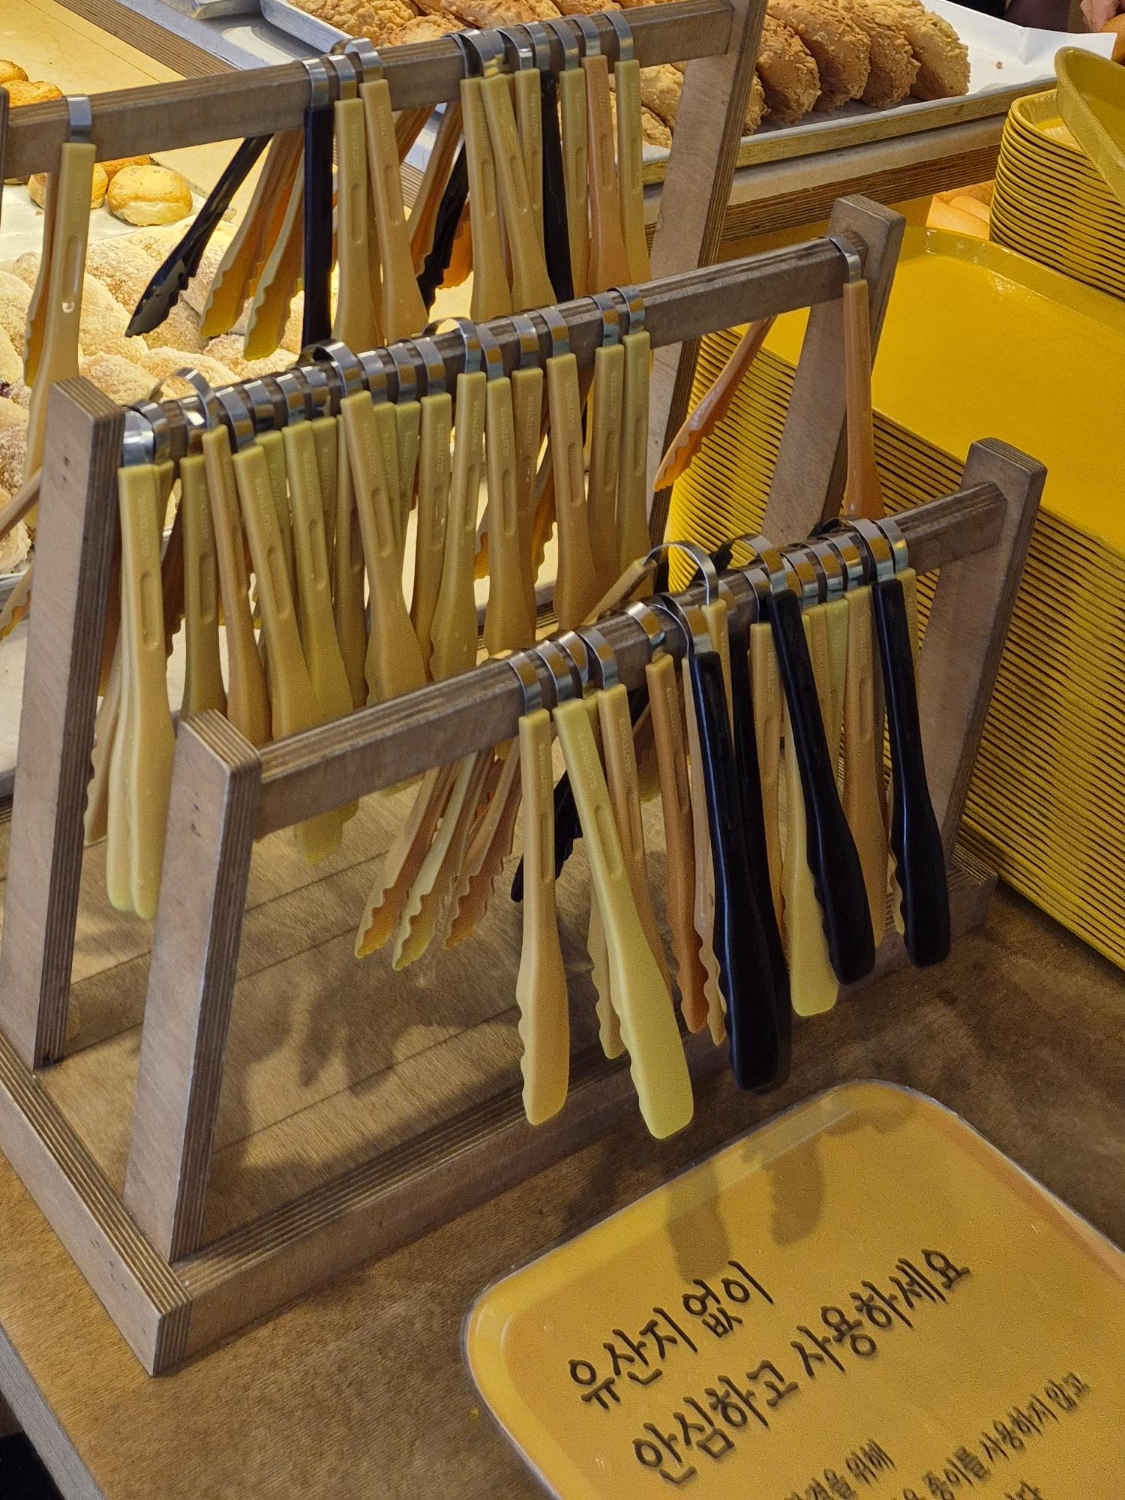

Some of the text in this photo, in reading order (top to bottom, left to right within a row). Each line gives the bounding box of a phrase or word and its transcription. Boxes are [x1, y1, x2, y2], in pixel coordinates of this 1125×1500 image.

[567, 1260, 774, 1411] 유산지 없이
[634, 1248, 971, 1486] 안심하고 사용하세요
[844, 1438, 896, 1487] 위해
[921, 1446, 991, 1500] 종이를
[978, 1392, 1061, 1465] 사용하지
